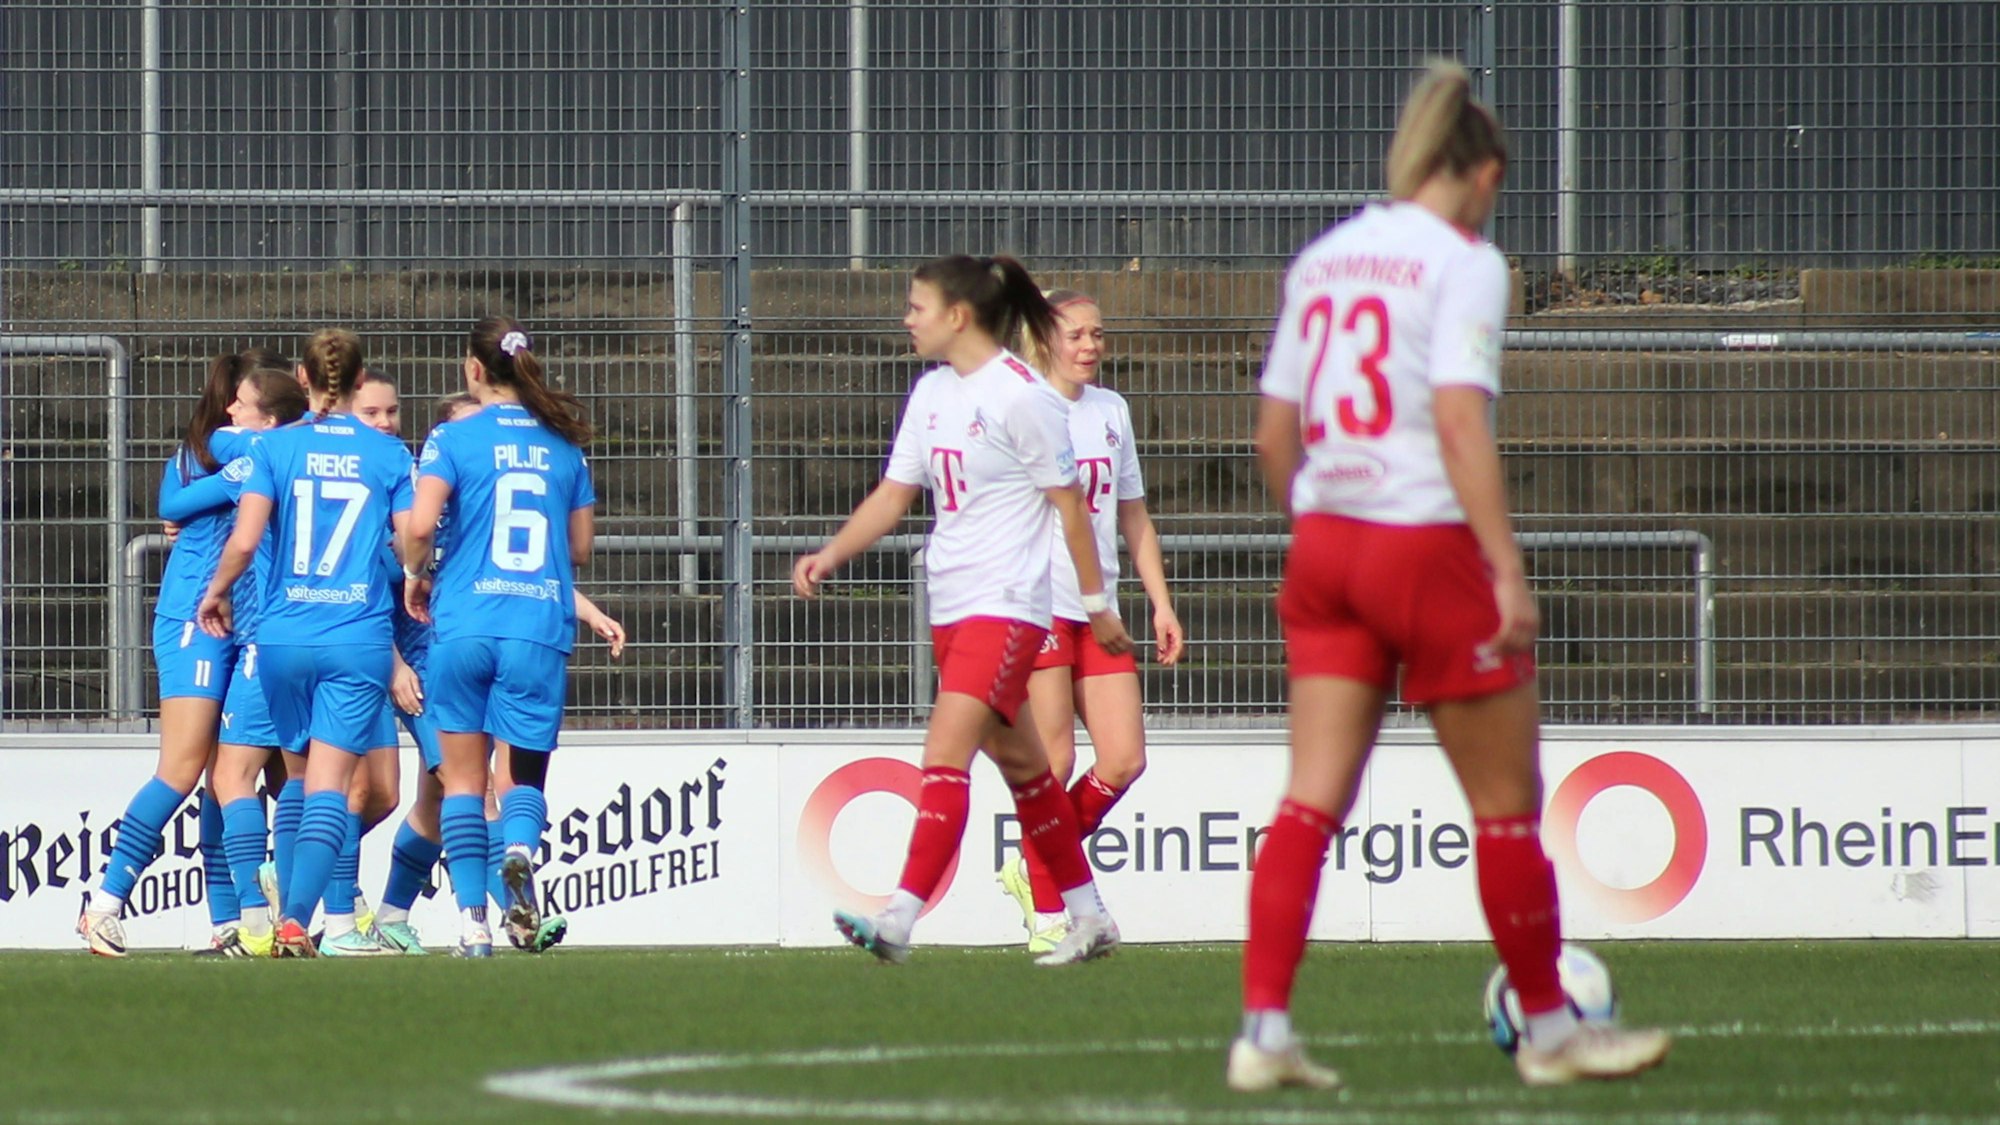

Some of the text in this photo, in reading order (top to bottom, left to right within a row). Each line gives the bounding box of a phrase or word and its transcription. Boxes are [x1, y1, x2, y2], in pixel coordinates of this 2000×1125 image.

[1301, 296, 1393, 444] 23
[306, 453, 360, 478] RIEKE
[494, 444, 550, 471] PILJIC
[293, 479, 370, 576] 17
[491, 472, 548, 572] 6
[286, 585, 350, 602] visitessen
[474, 578, 544, 599] visitessen
[195, 660, 211, 687] 11
[1740, 807, 2000, 867] RheinE
